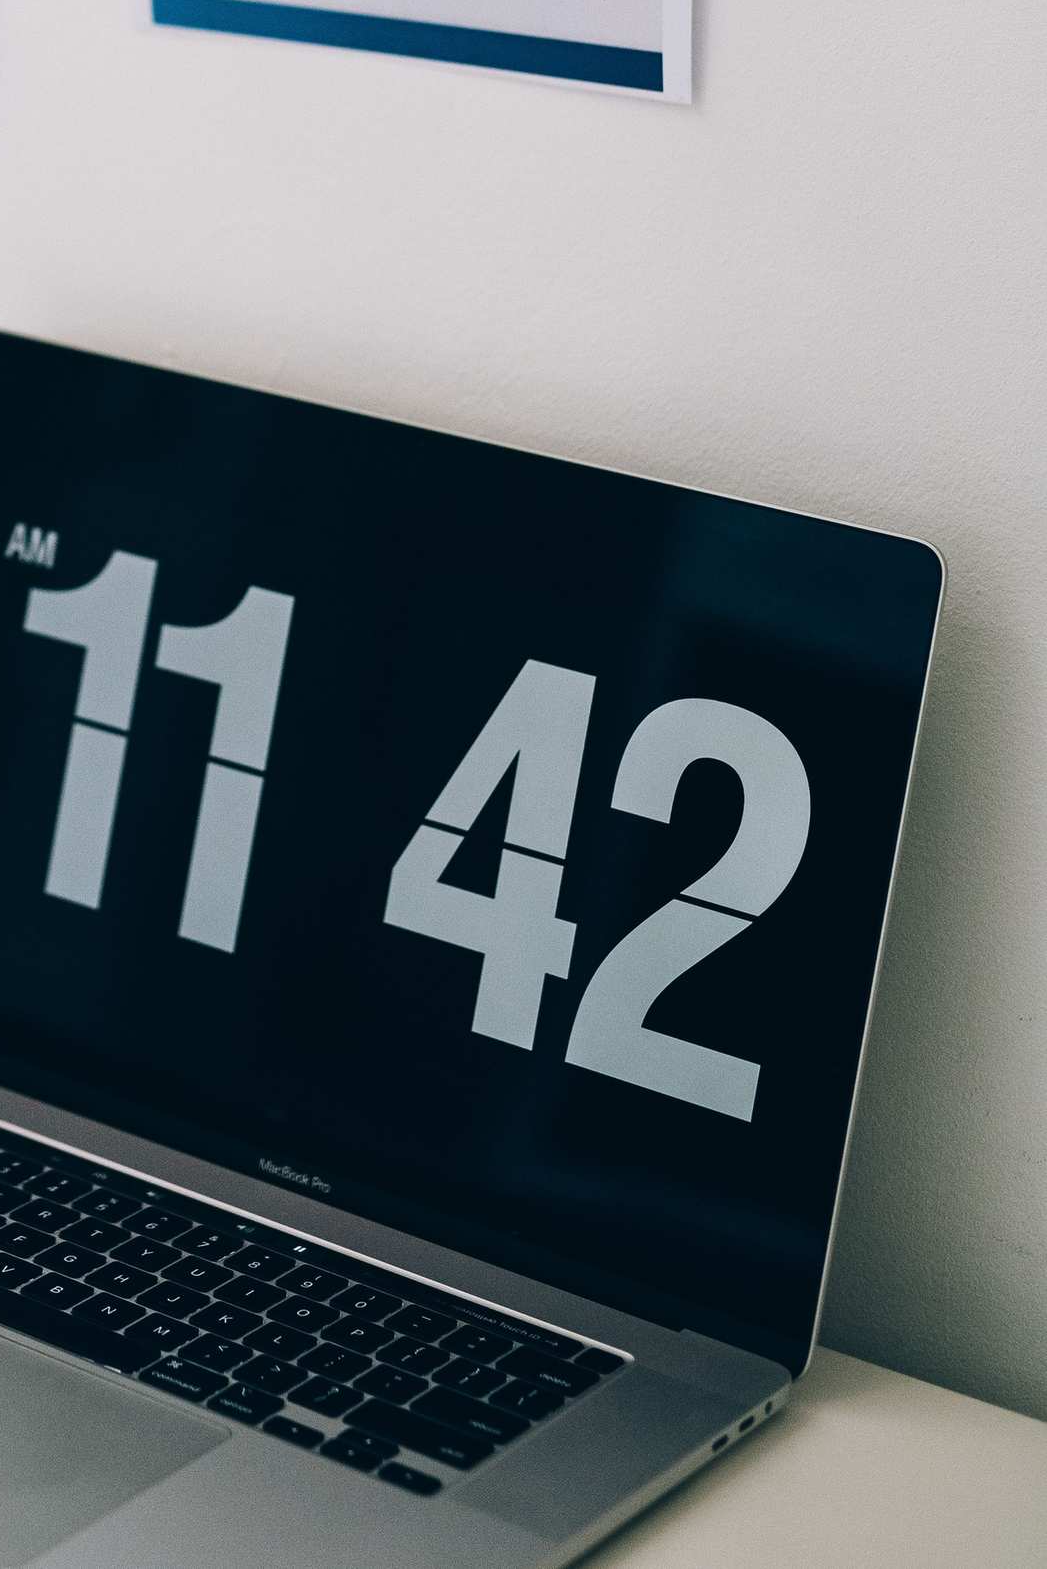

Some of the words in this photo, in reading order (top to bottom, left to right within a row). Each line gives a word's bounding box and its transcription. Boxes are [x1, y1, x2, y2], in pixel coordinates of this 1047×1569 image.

[5, 522, 58, 568] AM
[24, 549, 295, 955] 11
[383, 658, 811, 1124] 42
[258, 1158, 309, 1185] MacBook
[312, 1176, 331, 1193] Pro
[38, 1210, 52, 1219] R
[145, 1222, 158, 1230] 6
[89, 1229, 103, 1237] T
[12, 1234, 28, 1243] F
[140, 1248, 155, 1257] Y
[63, 1254, 78, 1263] G
[1, 1264, 16, 1274] V
[248, 1261, 261, 1269] 8
[190, 1267, 205, 1277] U
[113, 1274, 129, 1283] H
[49, 1285, 64, 1295] B
[167, 1295, 181, 1303] J
[100, 1305, 117, 1316] N
[296, 1308, 311, 1317] O
[218, 1313, 234, 1324] K
[153, 1325, 171, 1336] M
[350, 1328, 365, 1337] P
[273, 1335, 283, 1344] L
